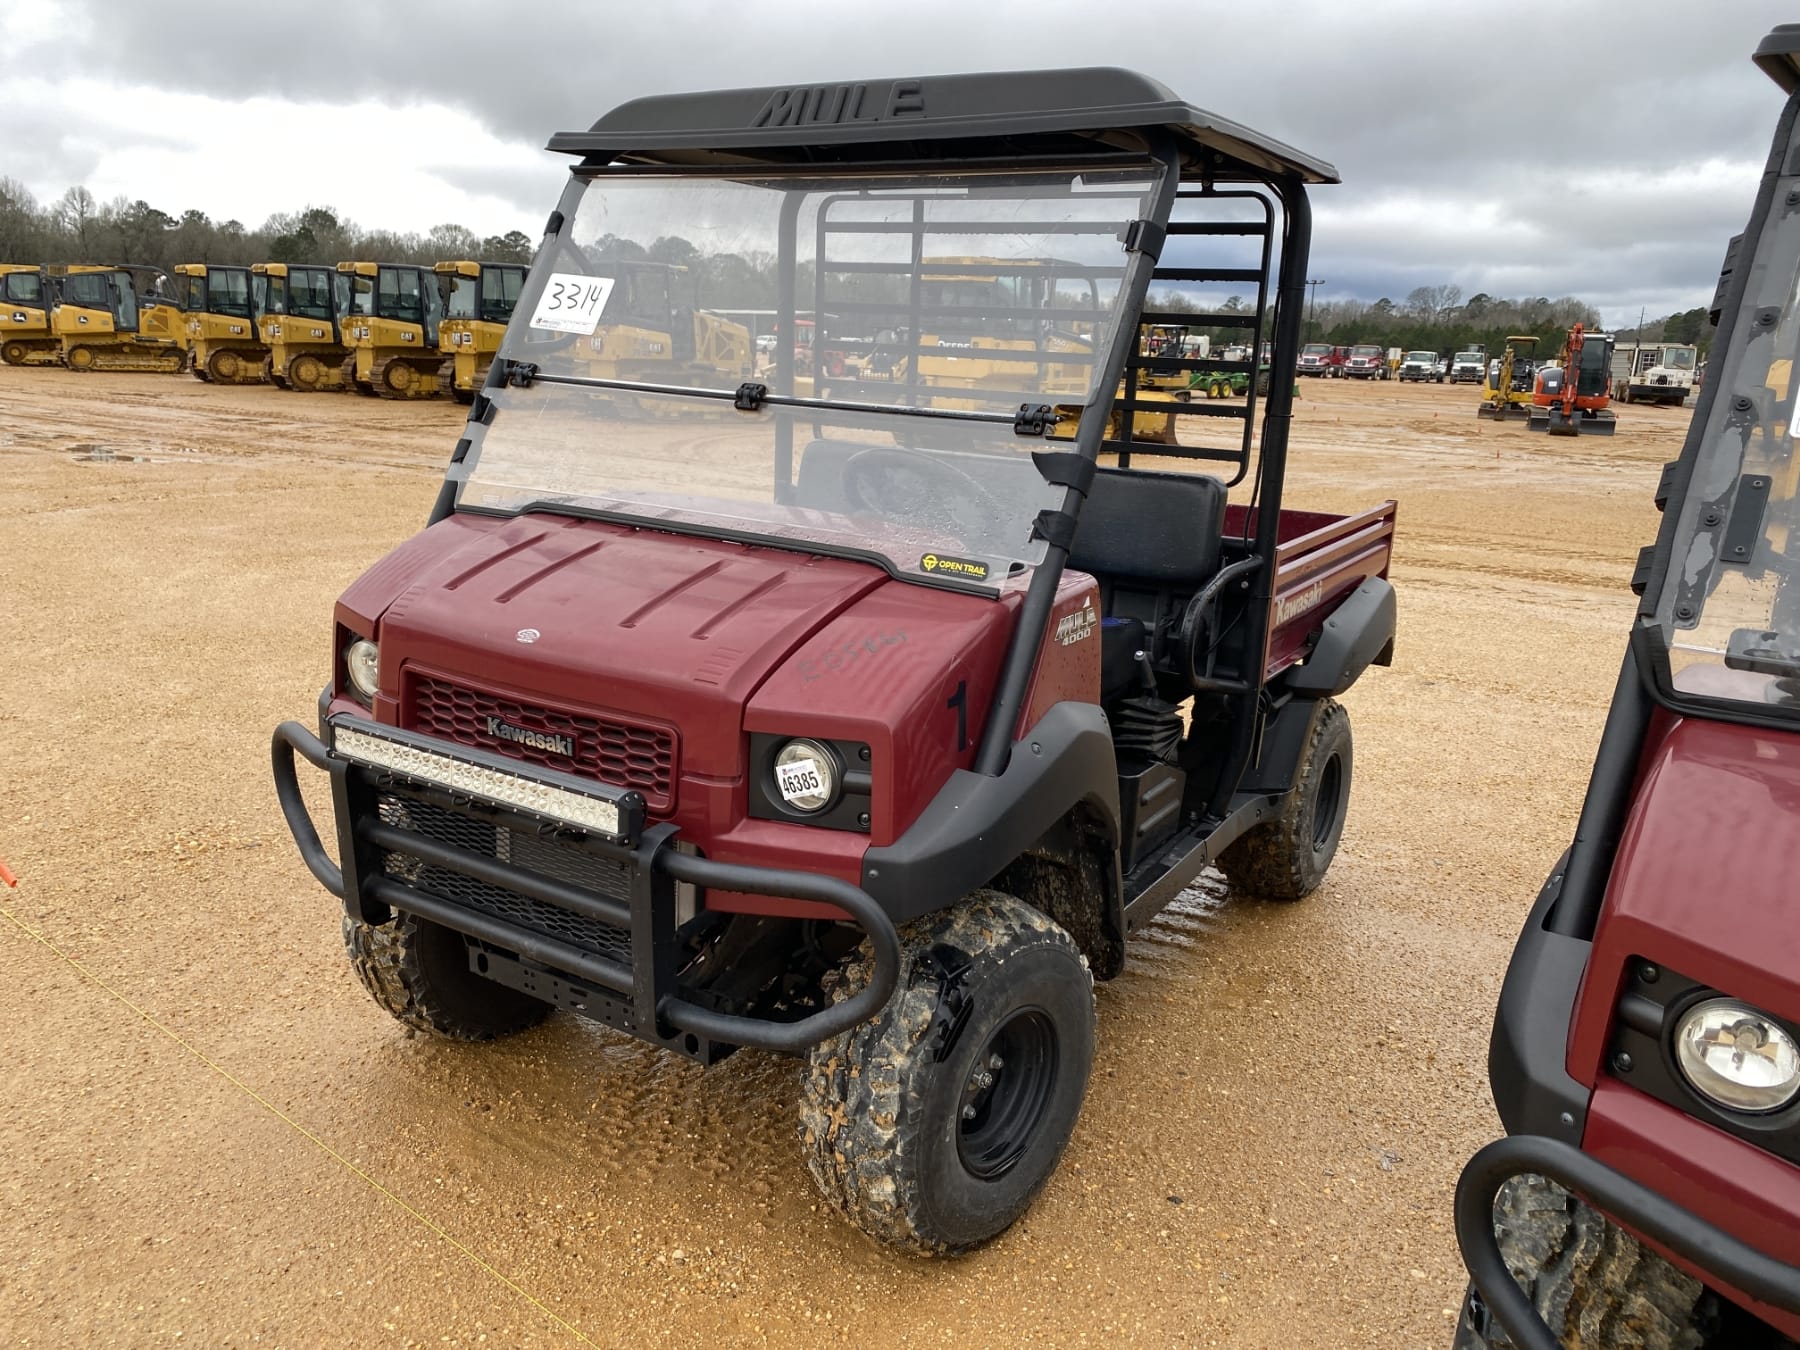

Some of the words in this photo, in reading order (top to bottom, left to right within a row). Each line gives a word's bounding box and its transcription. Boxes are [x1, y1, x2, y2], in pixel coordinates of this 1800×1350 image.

[750, 80, 925, 127] MULE
[548, 282, 603, 316] 3314
[400, 331, 414, 341] CAT
[939, 560, 963, 571] OPEN
[964, 563, 986, 575] TRAIL
[1276, 580, 1322, 625] Kawasaki
[1054, 607, 1097, 641] MULE
[946, 680, 966, 752] 1
[487, 716, 573, 757] Kawasaki
[782, 771, 819, 794] 46385
